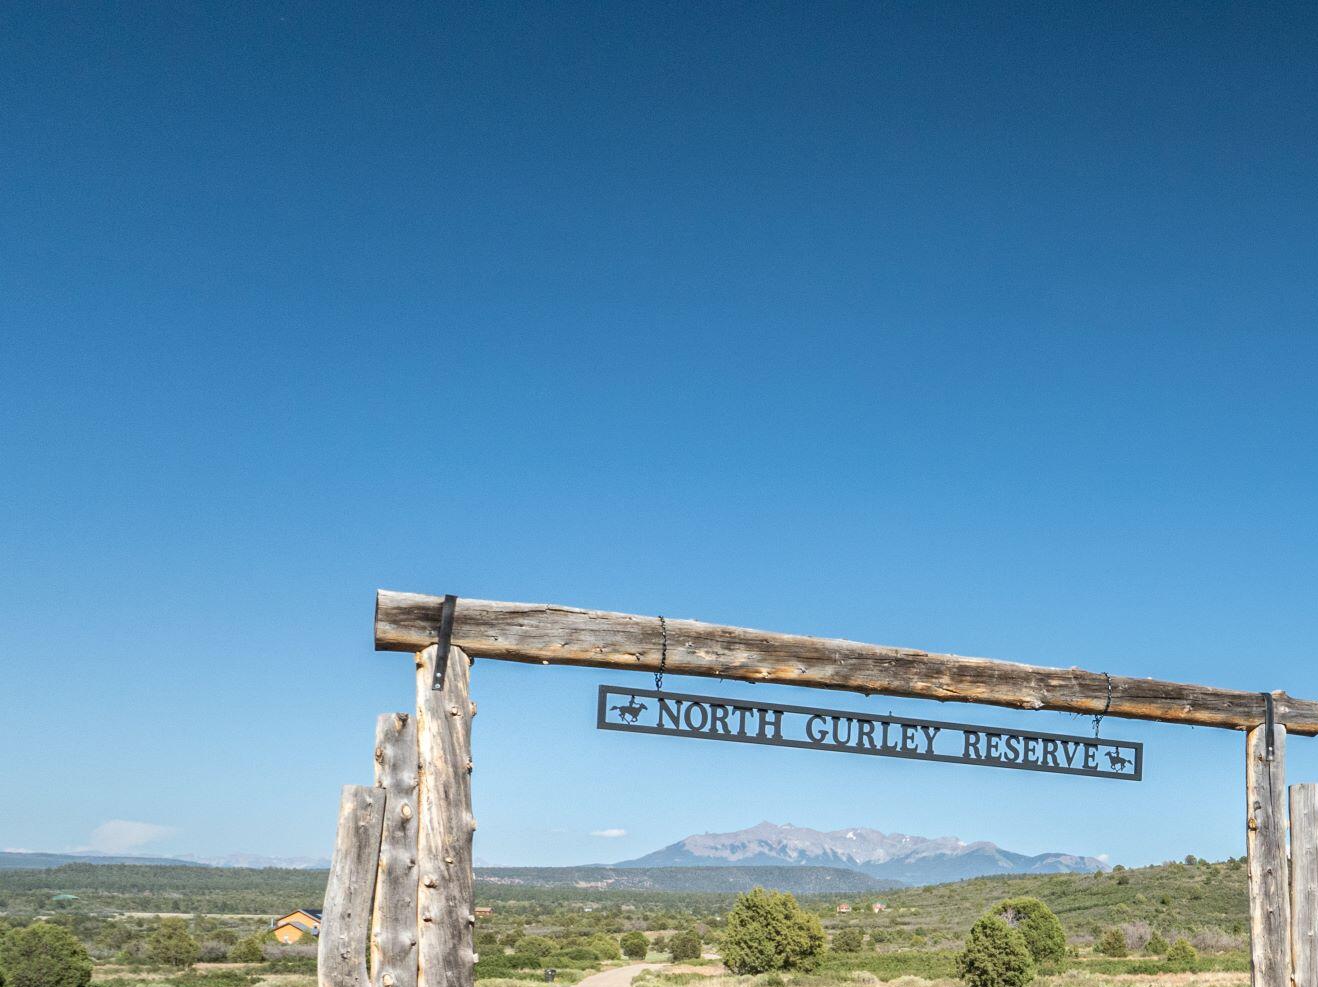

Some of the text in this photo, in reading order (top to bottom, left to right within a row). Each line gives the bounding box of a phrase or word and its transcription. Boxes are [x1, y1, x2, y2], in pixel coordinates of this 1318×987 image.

[657, 698, 1099, 770] NORTH GURLEY RESERVE
